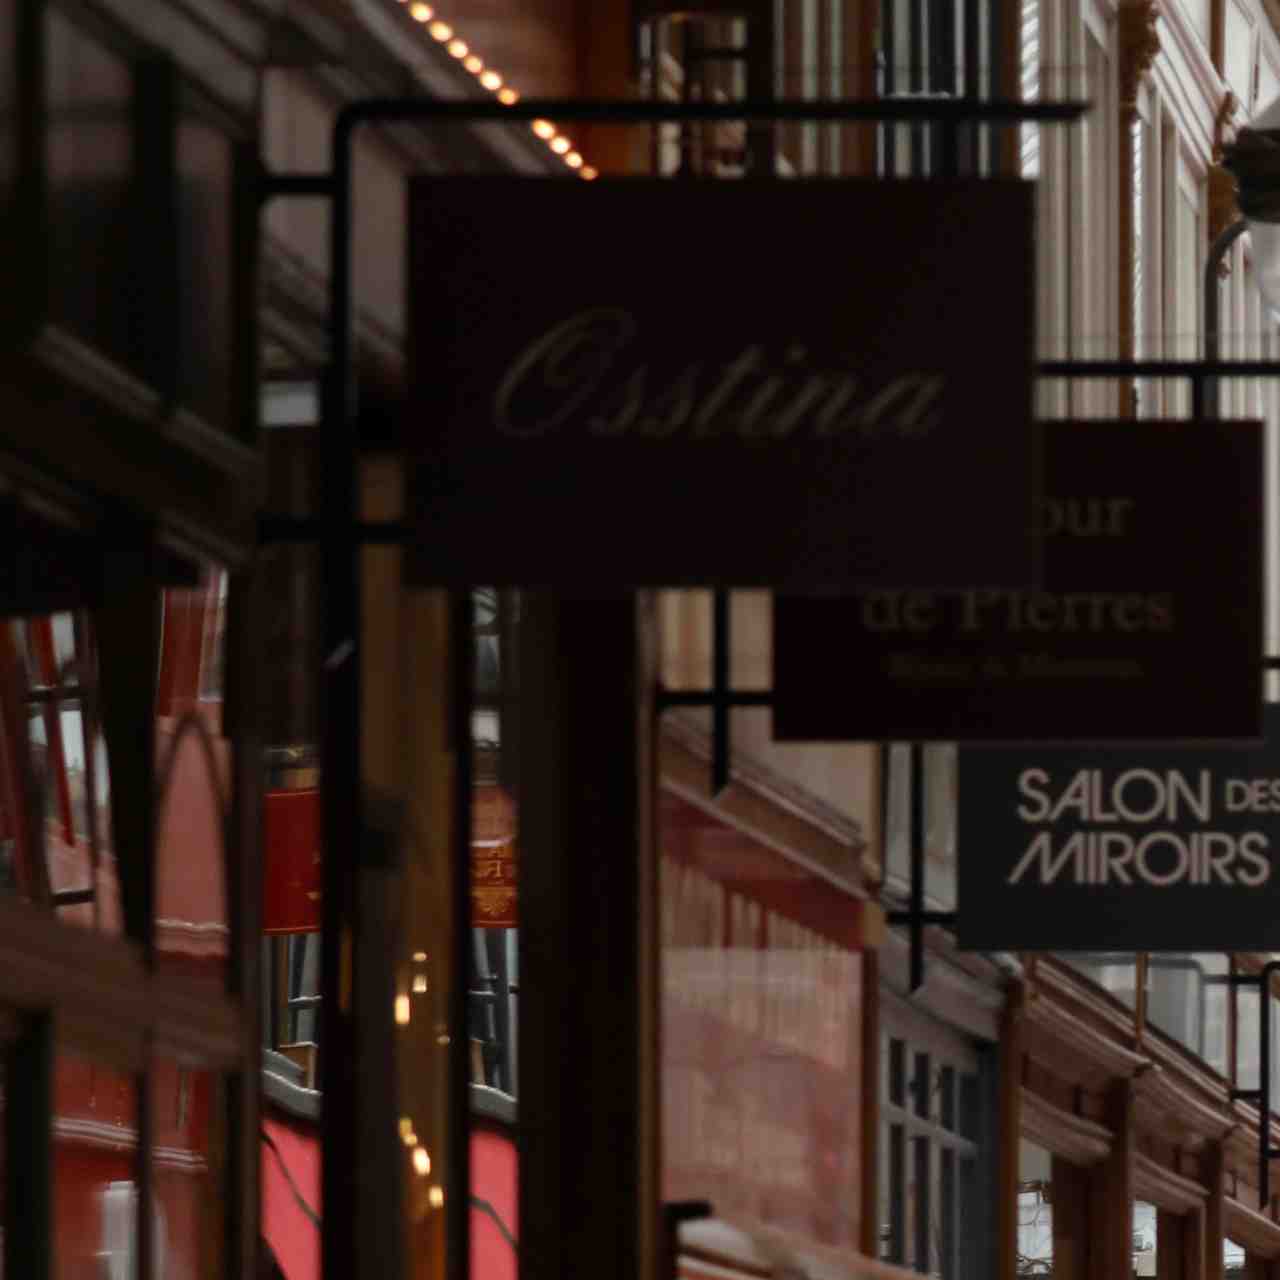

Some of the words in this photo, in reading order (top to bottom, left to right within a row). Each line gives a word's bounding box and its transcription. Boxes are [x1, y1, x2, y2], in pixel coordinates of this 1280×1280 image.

[493, 303, 945, 438] Osstina
[1016, 766, 1212, 823] SALON
[1006, 831, 1271, 887] MIROIRS
